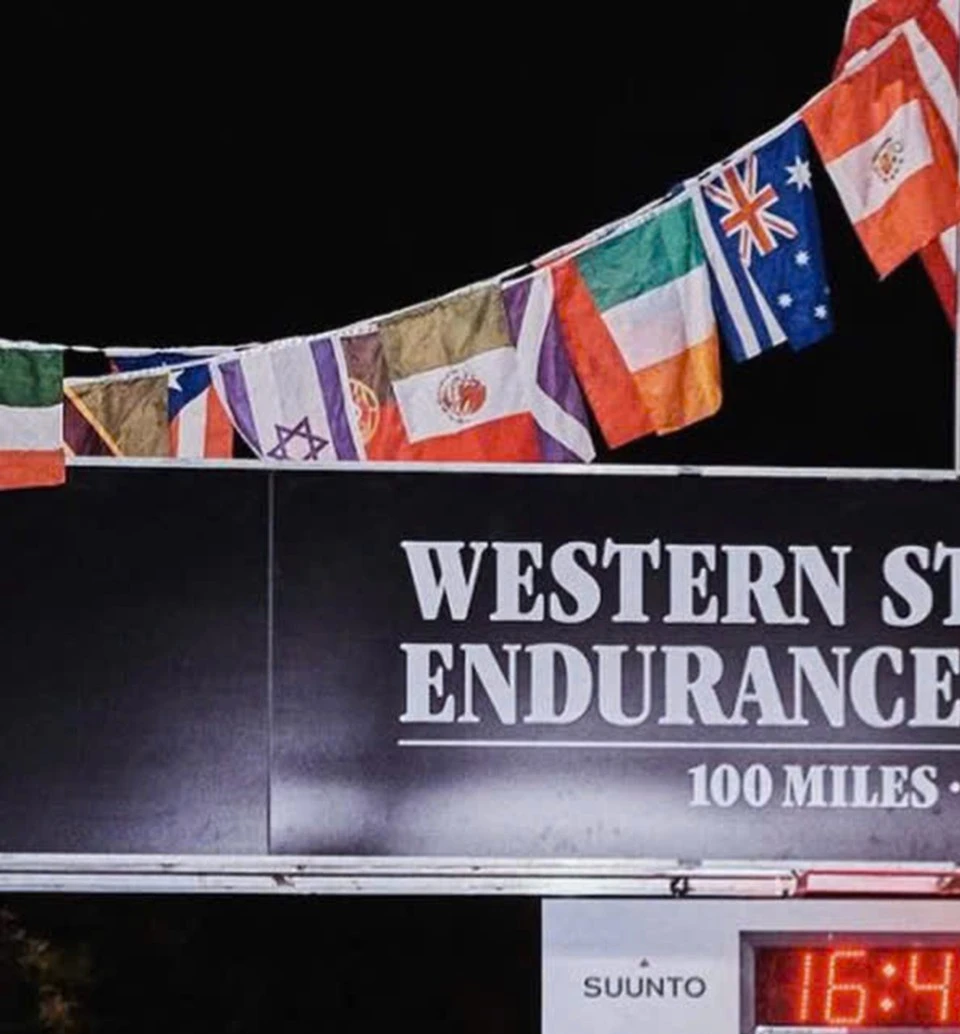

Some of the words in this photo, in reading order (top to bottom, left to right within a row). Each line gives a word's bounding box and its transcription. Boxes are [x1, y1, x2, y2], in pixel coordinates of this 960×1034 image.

[400, 537, 853, 627] WESTERN
[687, 763, 773, 808] 100
[782, 764, 938, 810] MILES
[583, 975, 707, 999] SUUNTO
